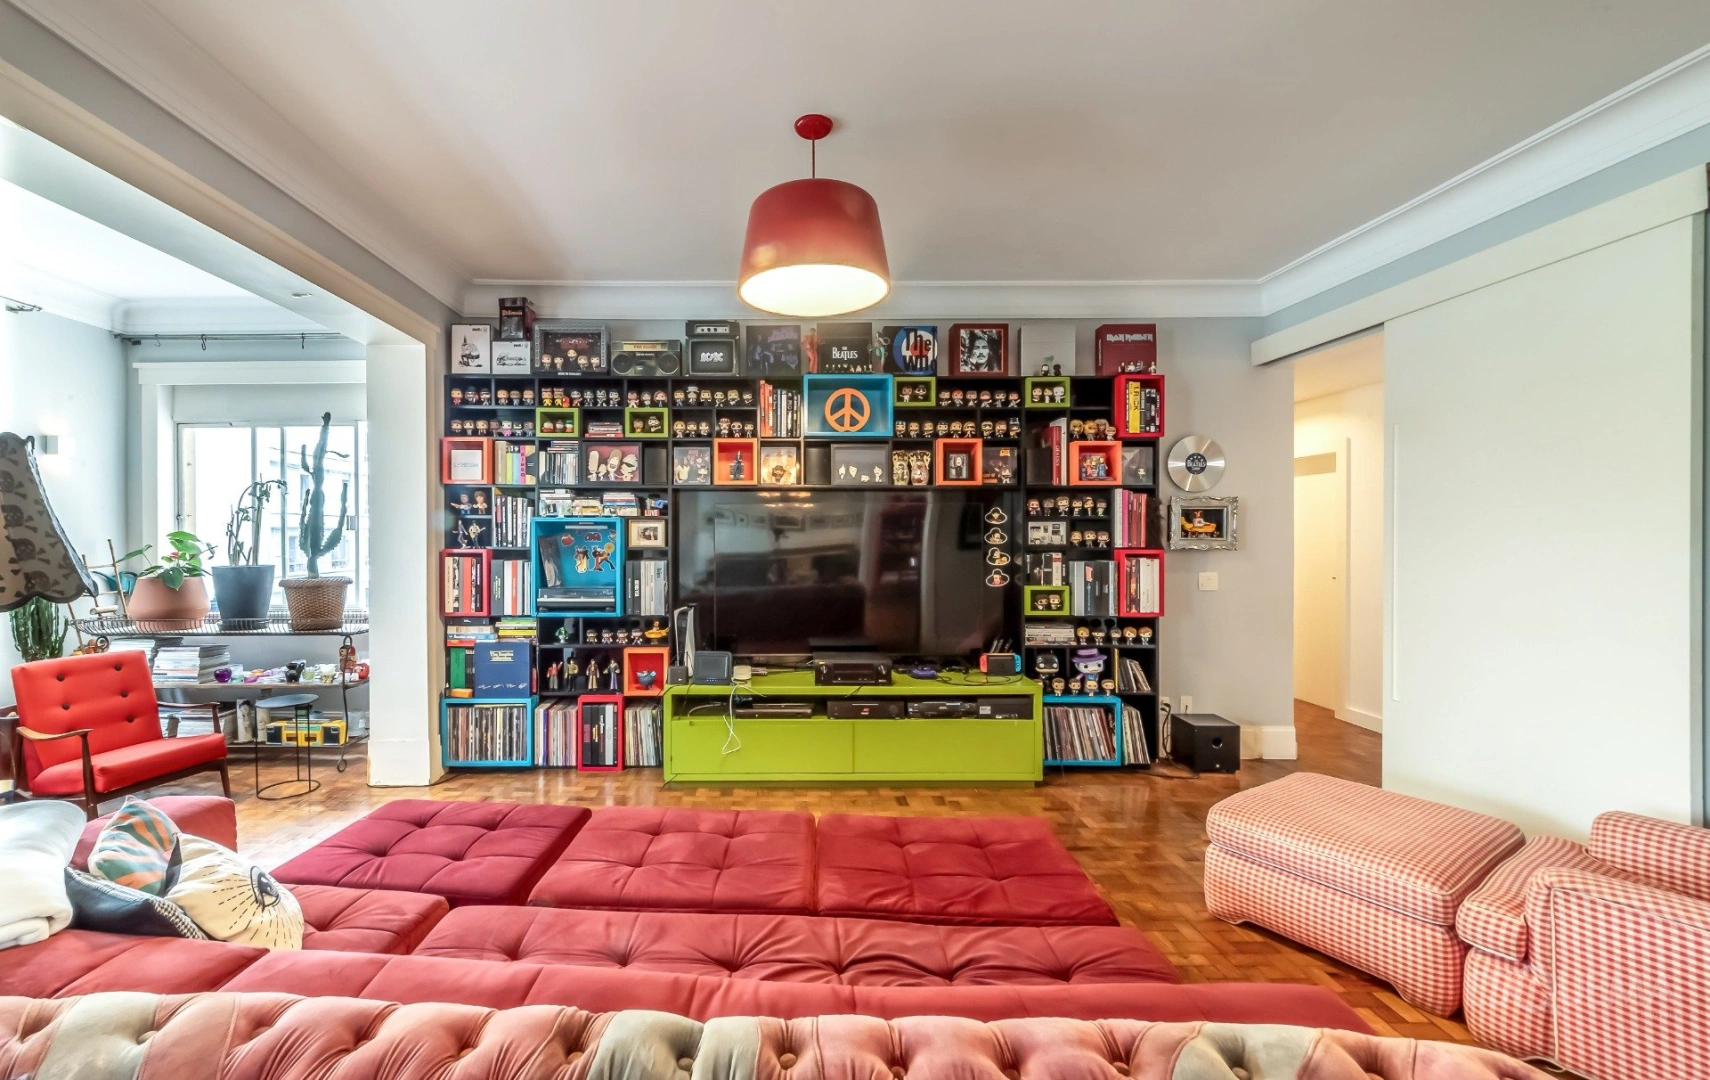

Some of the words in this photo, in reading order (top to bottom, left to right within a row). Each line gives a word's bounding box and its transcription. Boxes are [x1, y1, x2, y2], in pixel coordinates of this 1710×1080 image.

[904, 328, 932, 352] The
[700, 352, 723, 362] AC/DC
[832, 346, 858, 360] BEATLES
